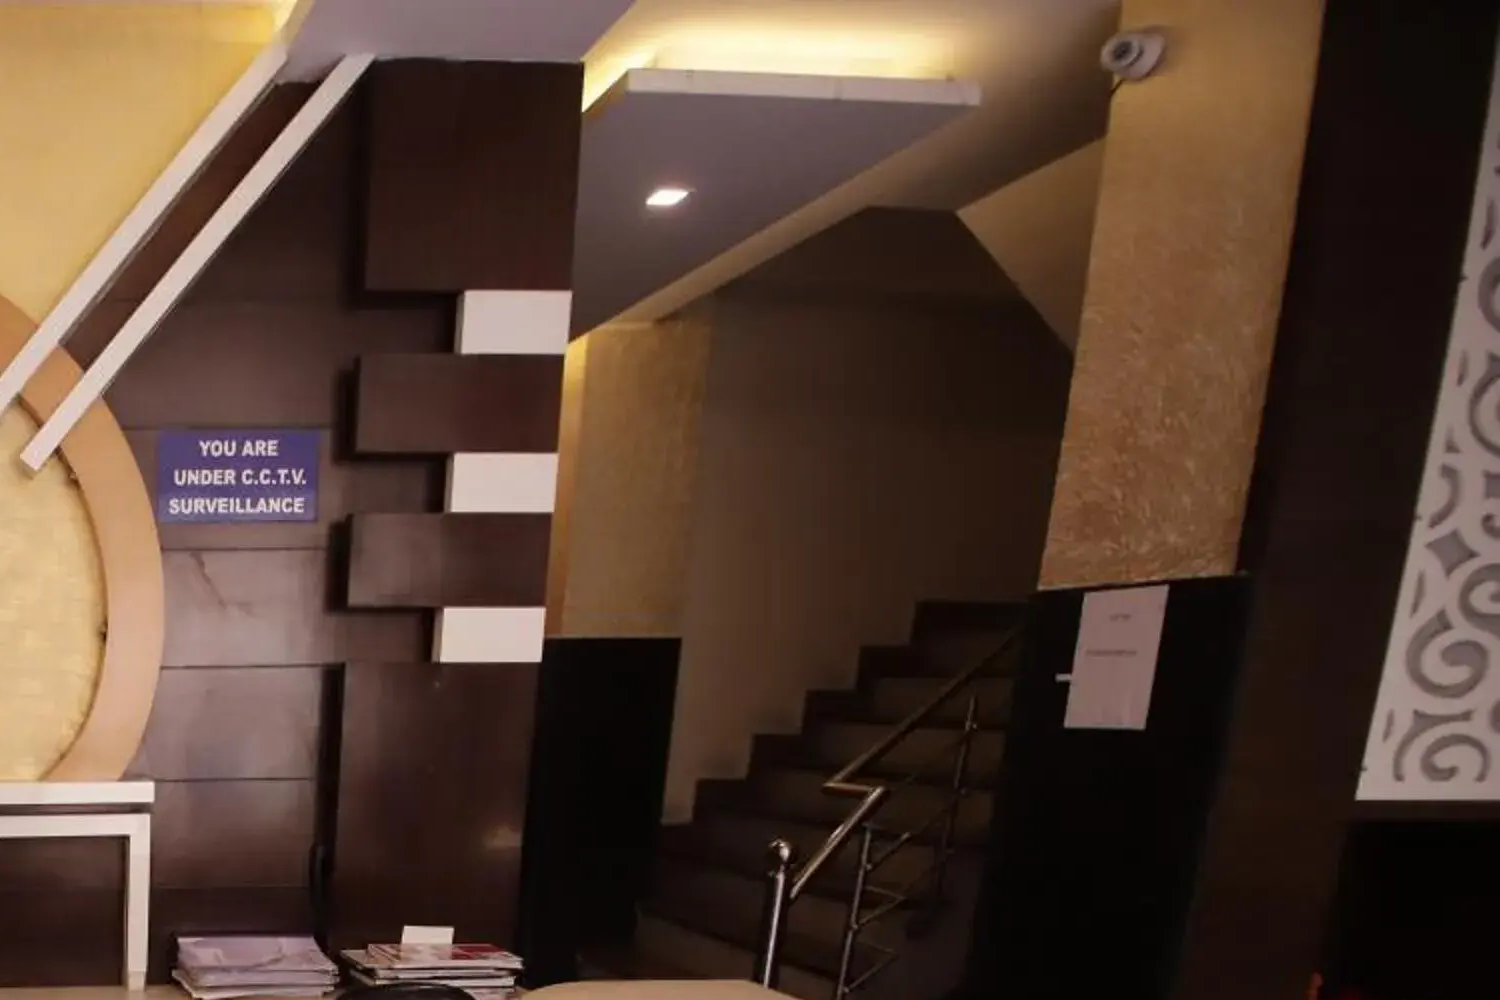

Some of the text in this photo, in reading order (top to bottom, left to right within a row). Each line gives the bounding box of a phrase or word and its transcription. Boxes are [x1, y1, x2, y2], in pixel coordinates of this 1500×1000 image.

[199, 439, 279, 457] YOU ARE
[173, 468, 307, 485] UNDER C.C.T.V.
[168, 497, 305, 514] SURVEILLANCE
